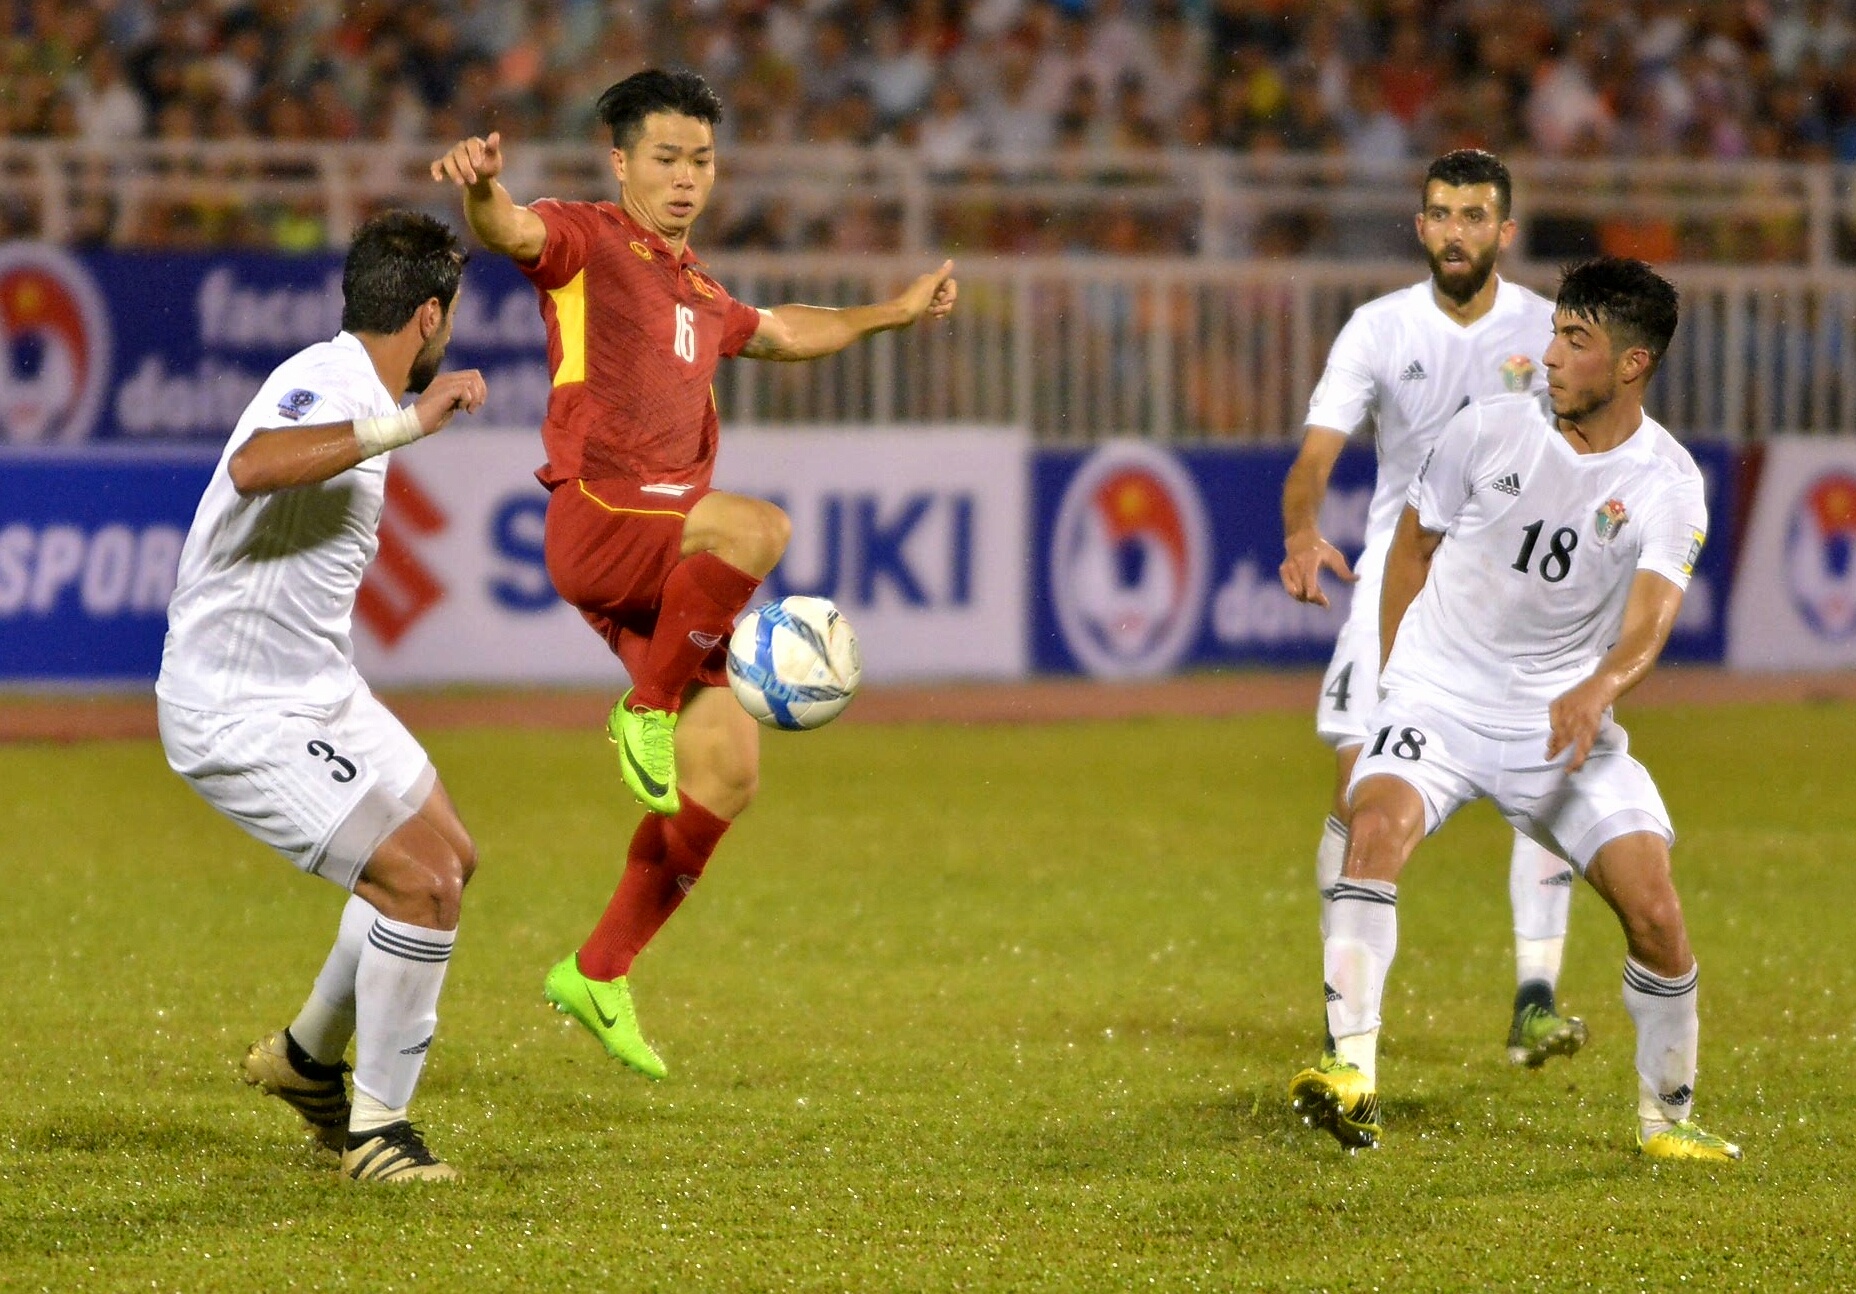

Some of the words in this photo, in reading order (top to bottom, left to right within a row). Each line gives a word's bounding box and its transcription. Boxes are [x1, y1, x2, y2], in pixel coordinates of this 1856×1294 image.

[674, 303, 695, 363] 16
[485, 490, 974, 615] SUKI
[1511, 519, 1578, 583] 18
[1325, 661, 1354, 712] 4
[307, 740, 357, 783] 3
[1367, 725, 1427, 761] 18
